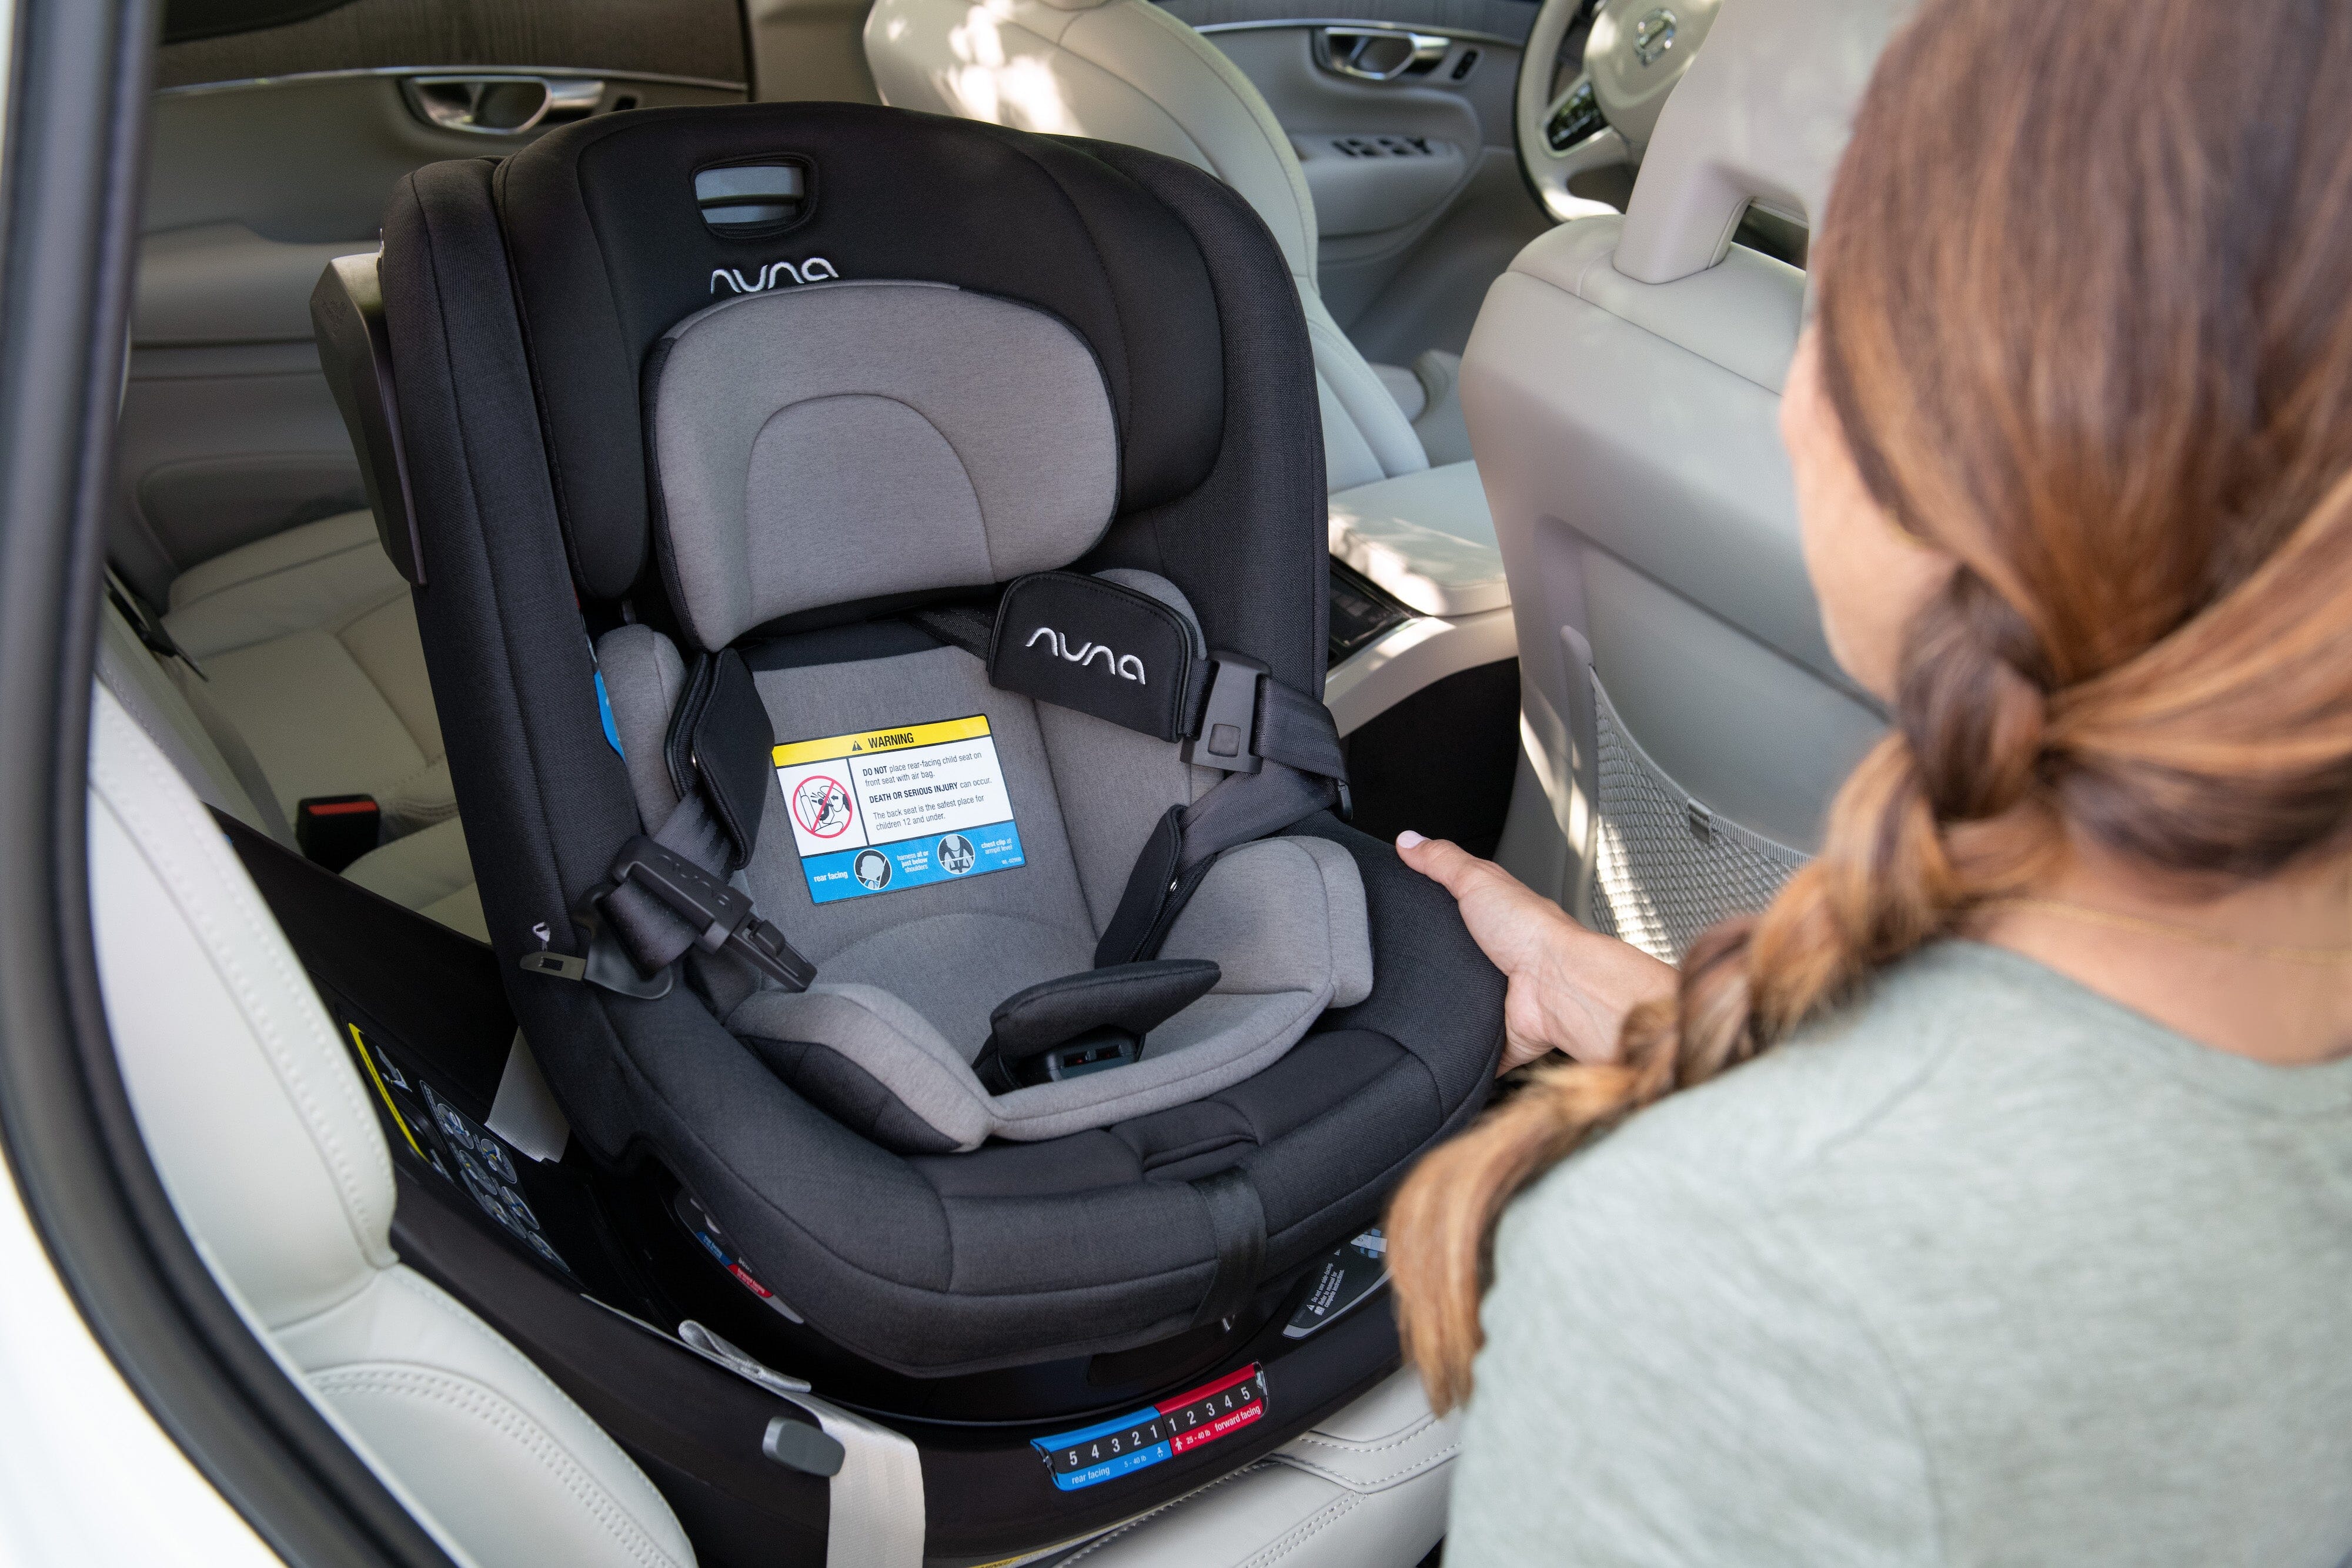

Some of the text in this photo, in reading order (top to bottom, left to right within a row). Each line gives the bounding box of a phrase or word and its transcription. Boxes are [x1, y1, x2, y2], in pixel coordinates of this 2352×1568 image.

[710, 258, 839, 293] nuna
[1025, 627, 1146, 685] nuna
[868, 733, 914, 748] WARNING
[874, 765, 887, 774] NOT
[890, 763, 906, 774] place
[907, 757, 941, 769] rear-facing
[943, 754, 957, 764] child
[959, 752, 973, 761] seat
[866, 779, 880, 787] front
[921, 770, 935, 780] bag.
[869, 777, 992, 803] DEATH OR SERIOUS INJURY can occur.
[873, 794, 985, 820] The back seat is the safest place for
[876, 821, 901, 831] children
[913, 816, 925, 824] and
[926, 813, 946, 823] under.
[996, 839, 1006, 847] clip
[901, 857, 928, 868] just below
[904, 864, 928, 873] shoulders
[813, 871, 848, 882] rear facing
[1169, 1386, 1251, 1432] 1 2 3 4 5
[1198, 1432, 1205, 1440] 40
[1214, 1413, 1241, 1432] forward
[1240, 1405, 1261, 1420] facing
[1070, 1424, 1158, 1466] 5 4 3 2 1
[1071, 1474, 1086, 1485] rear
[1088, 1466, 1110, 1480] facing
